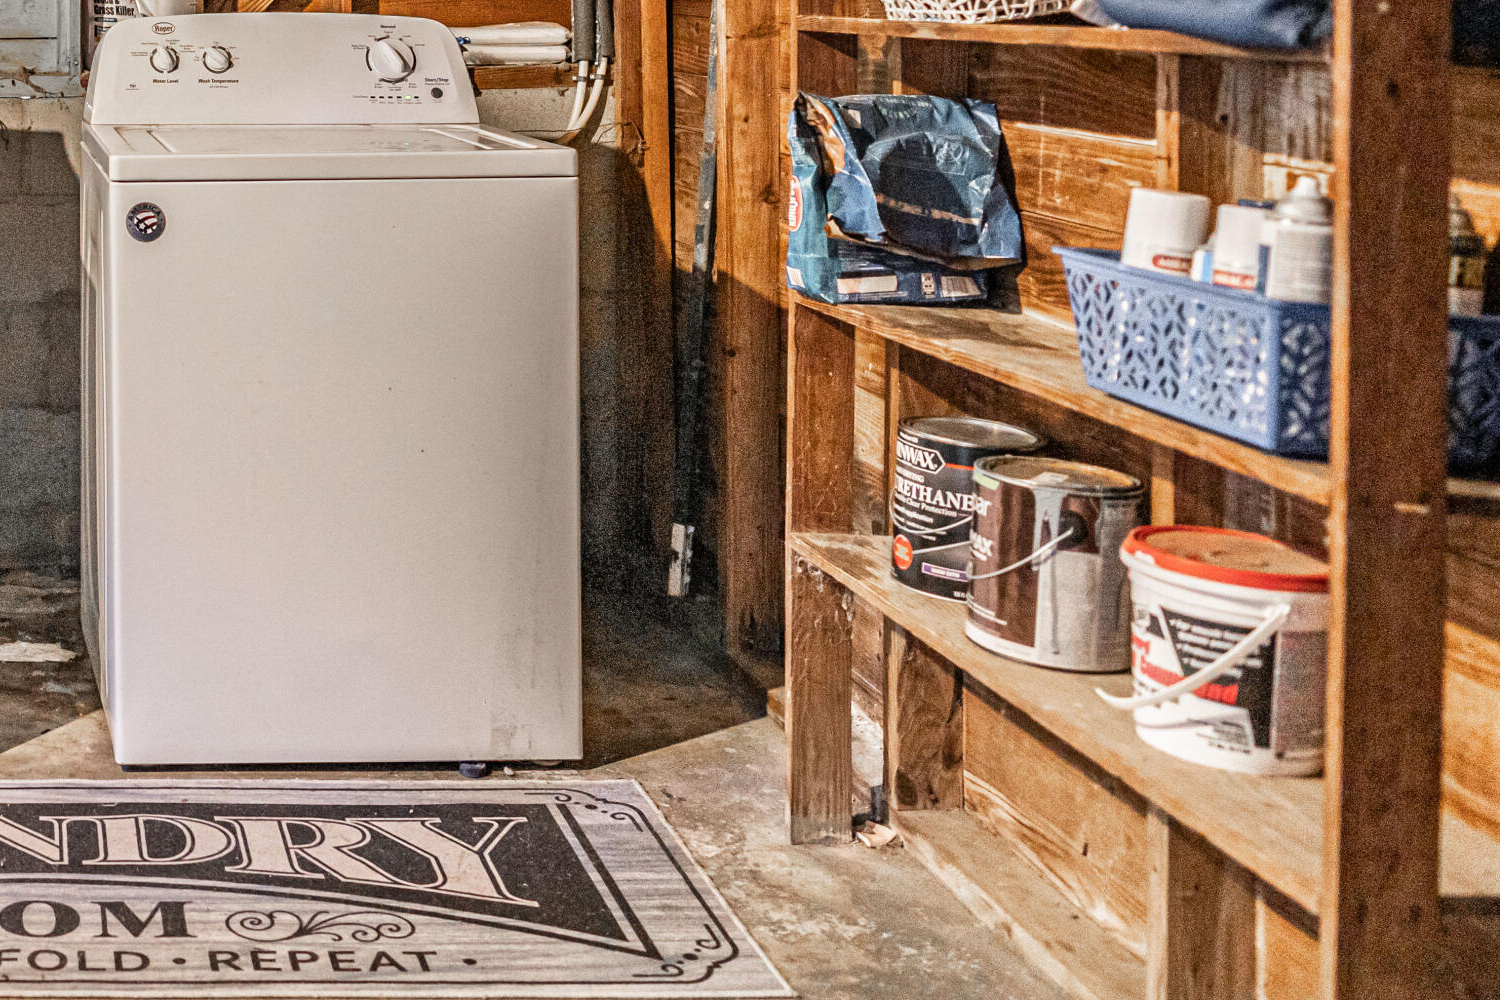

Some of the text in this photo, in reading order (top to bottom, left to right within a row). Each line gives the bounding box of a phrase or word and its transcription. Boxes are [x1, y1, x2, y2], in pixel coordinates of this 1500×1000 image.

[154, 24, 174, 33] Roper
[896, 441, 938, 471] NWAX
[208, 949, 438, 973] REPEAT
